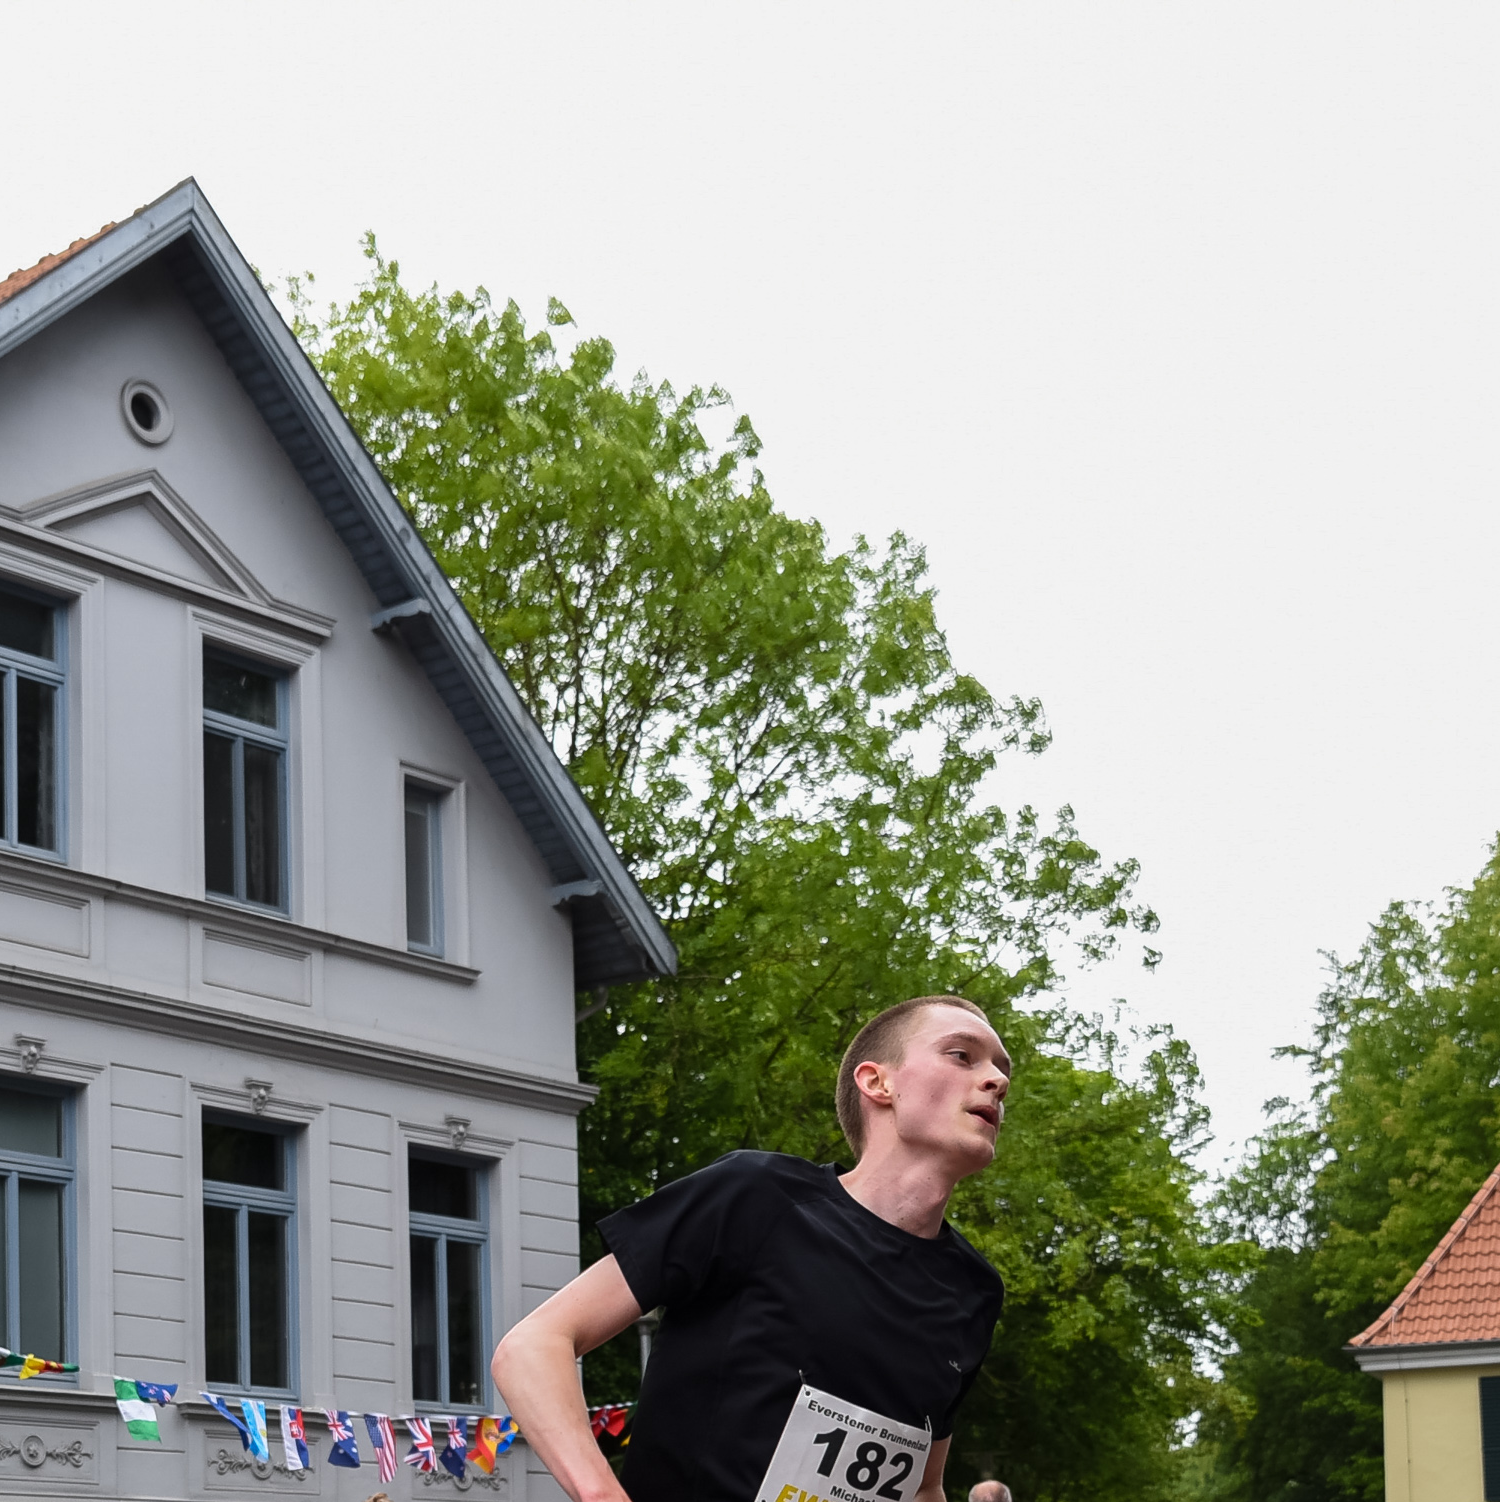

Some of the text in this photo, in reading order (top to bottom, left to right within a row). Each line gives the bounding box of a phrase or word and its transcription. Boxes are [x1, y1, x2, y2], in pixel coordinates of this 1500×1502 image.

[807, 1399, 929, 1453] Everstener Brunnenlauf
[813, 1427, 914, 1502] 182
